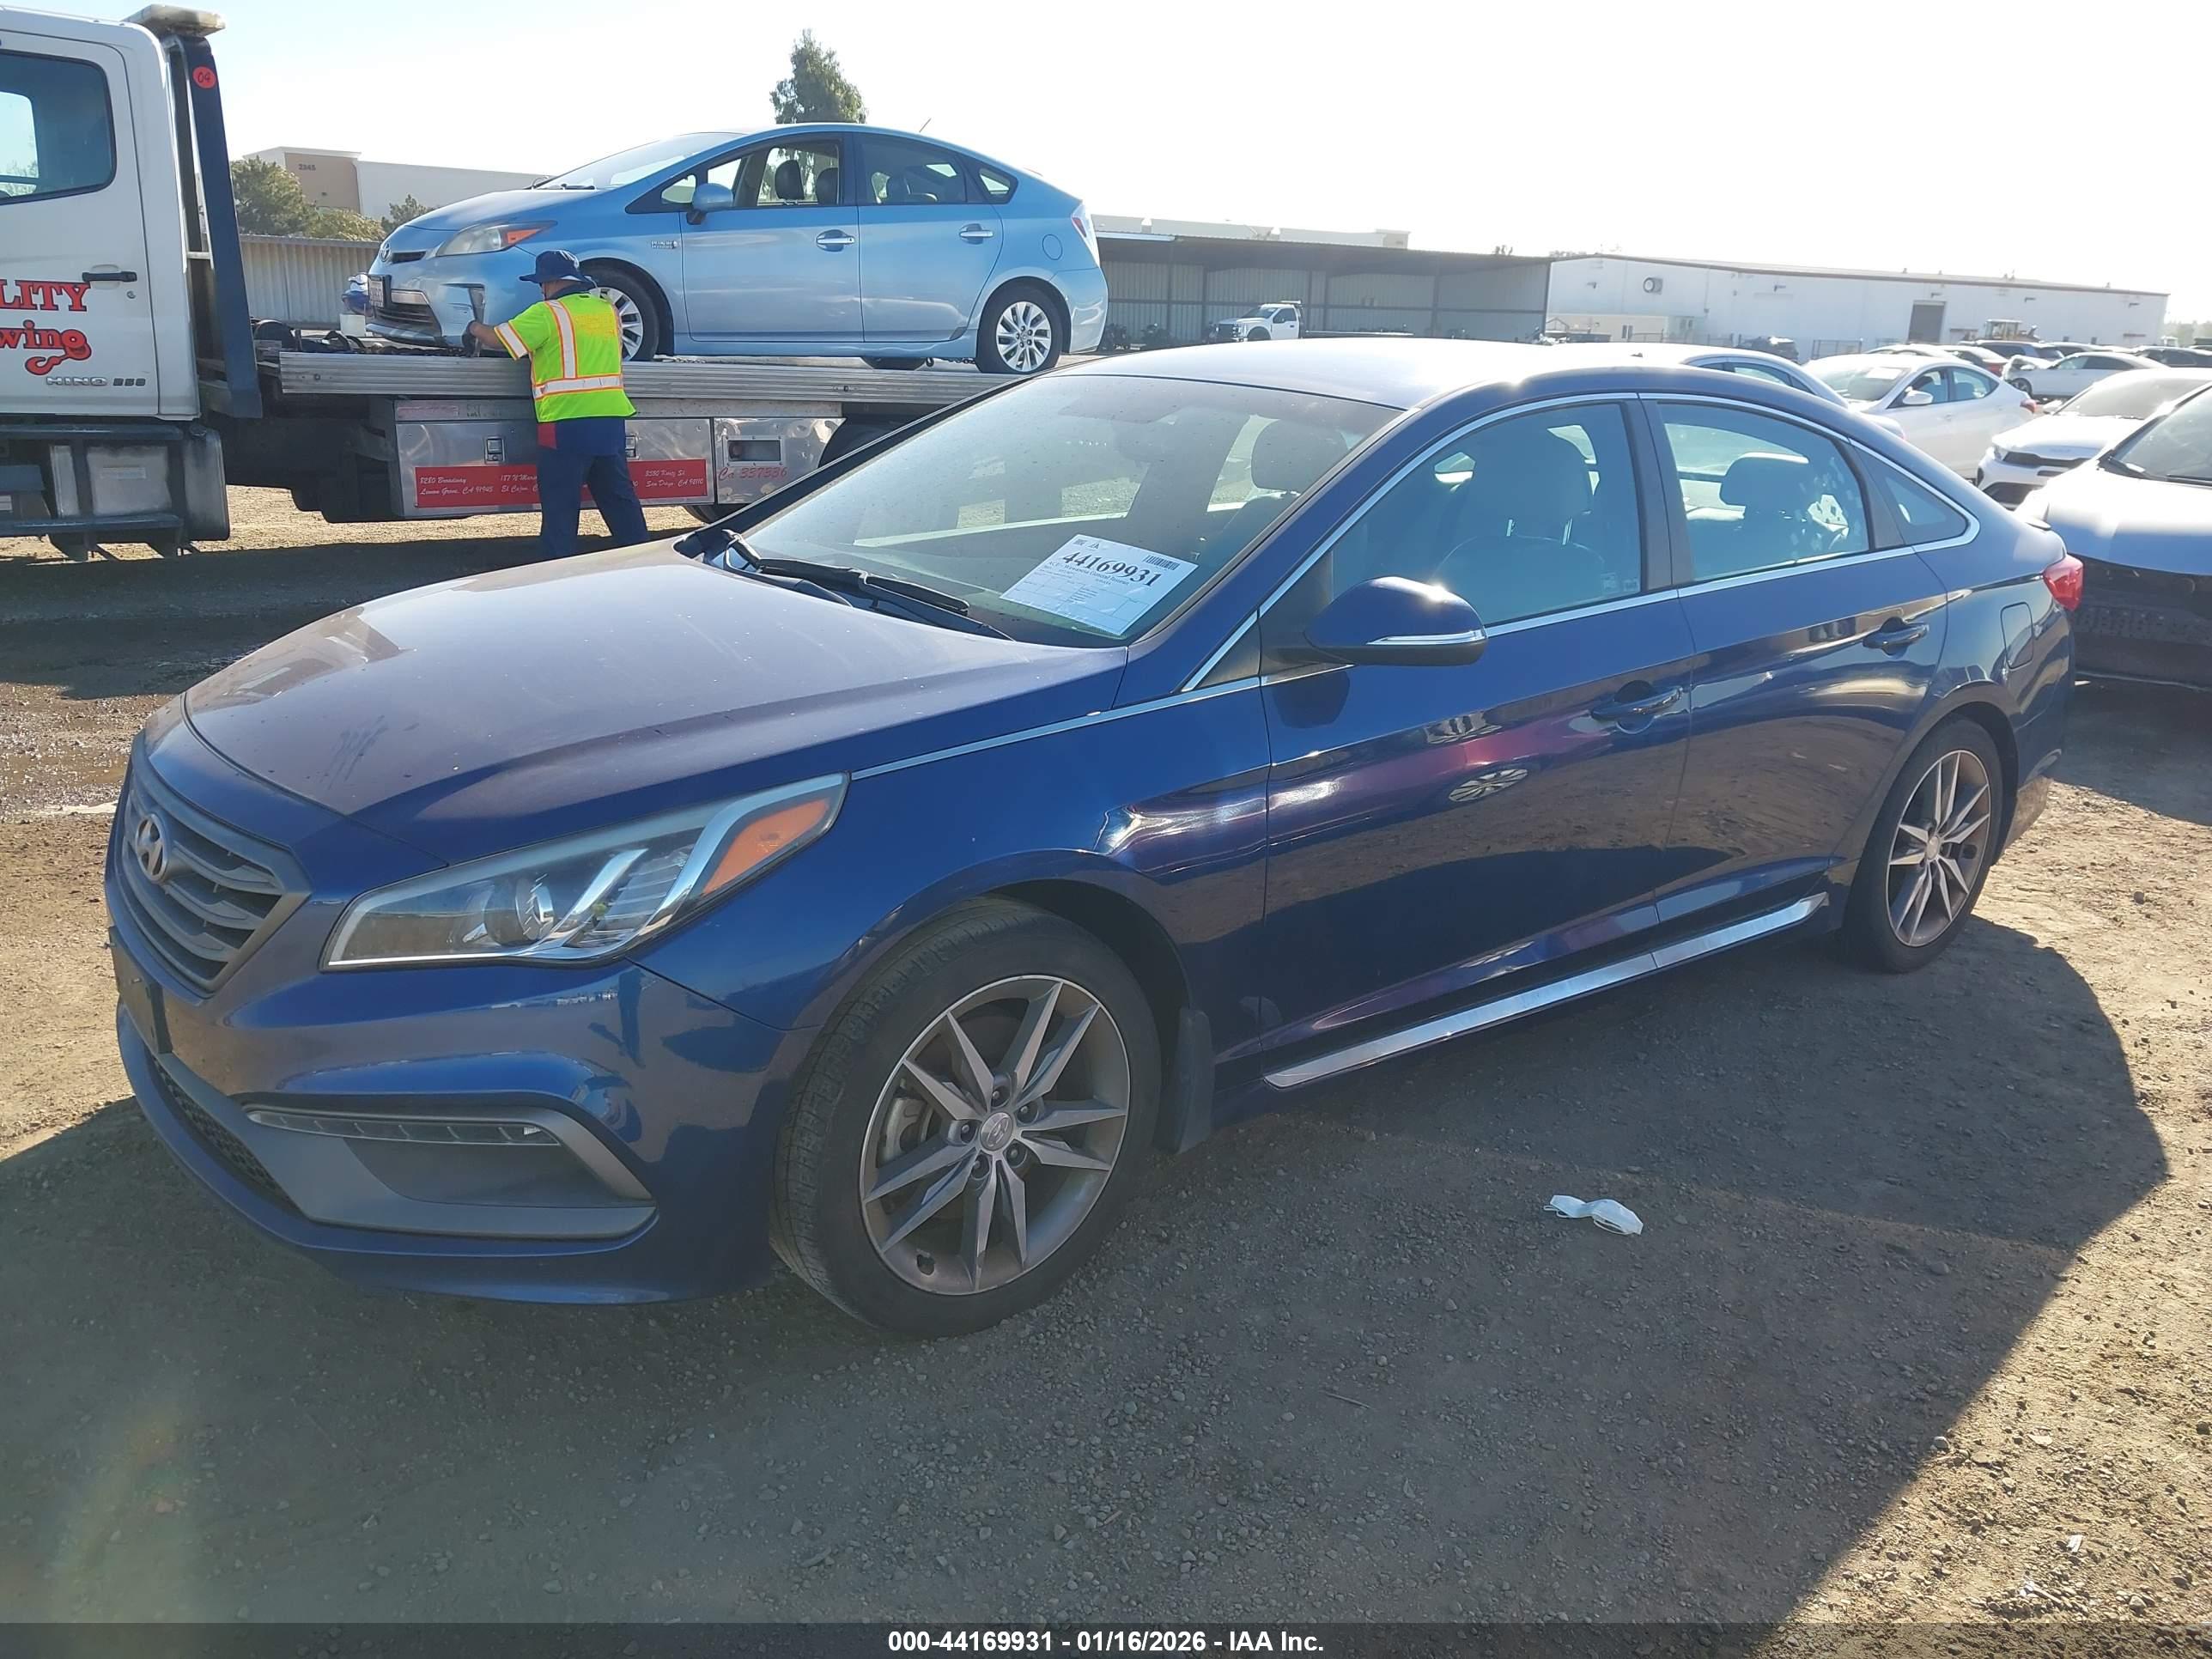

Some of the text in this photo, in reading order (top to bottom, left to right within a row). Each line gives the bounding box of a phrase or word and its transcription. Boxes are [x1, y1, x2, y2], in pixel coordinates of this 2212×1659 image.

[46, 376, 108, 386] HINO
[462, 486, 474, 495] CA
[1062, 551, 1162, 587] 44169931
